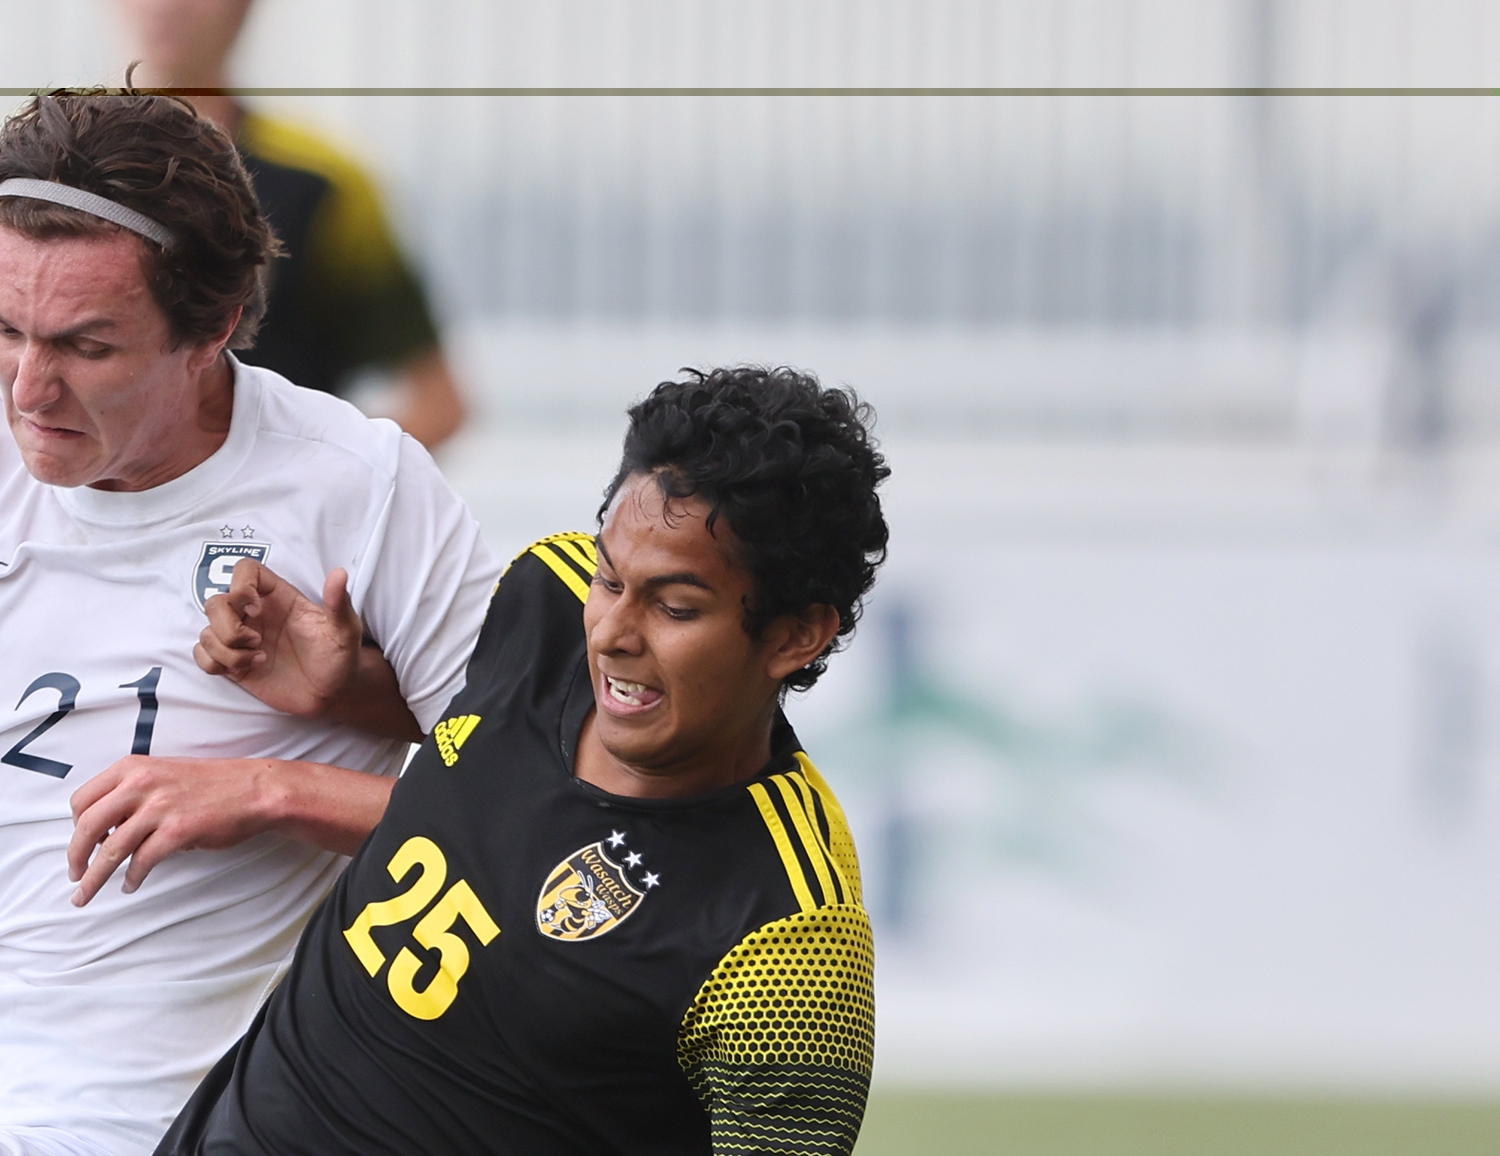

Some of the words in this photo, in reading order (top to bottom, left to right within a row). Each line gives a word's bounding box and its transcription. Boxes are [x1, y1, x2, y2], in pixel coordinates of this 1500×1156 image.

[208, 546, 261, 557] SKYLINE
[0, 667, 162, 780] 21
[434, 721, 459, 767] adidas
[581, 849, 633, 909] Wasatch
[343, 836, 501, 1021] 25
